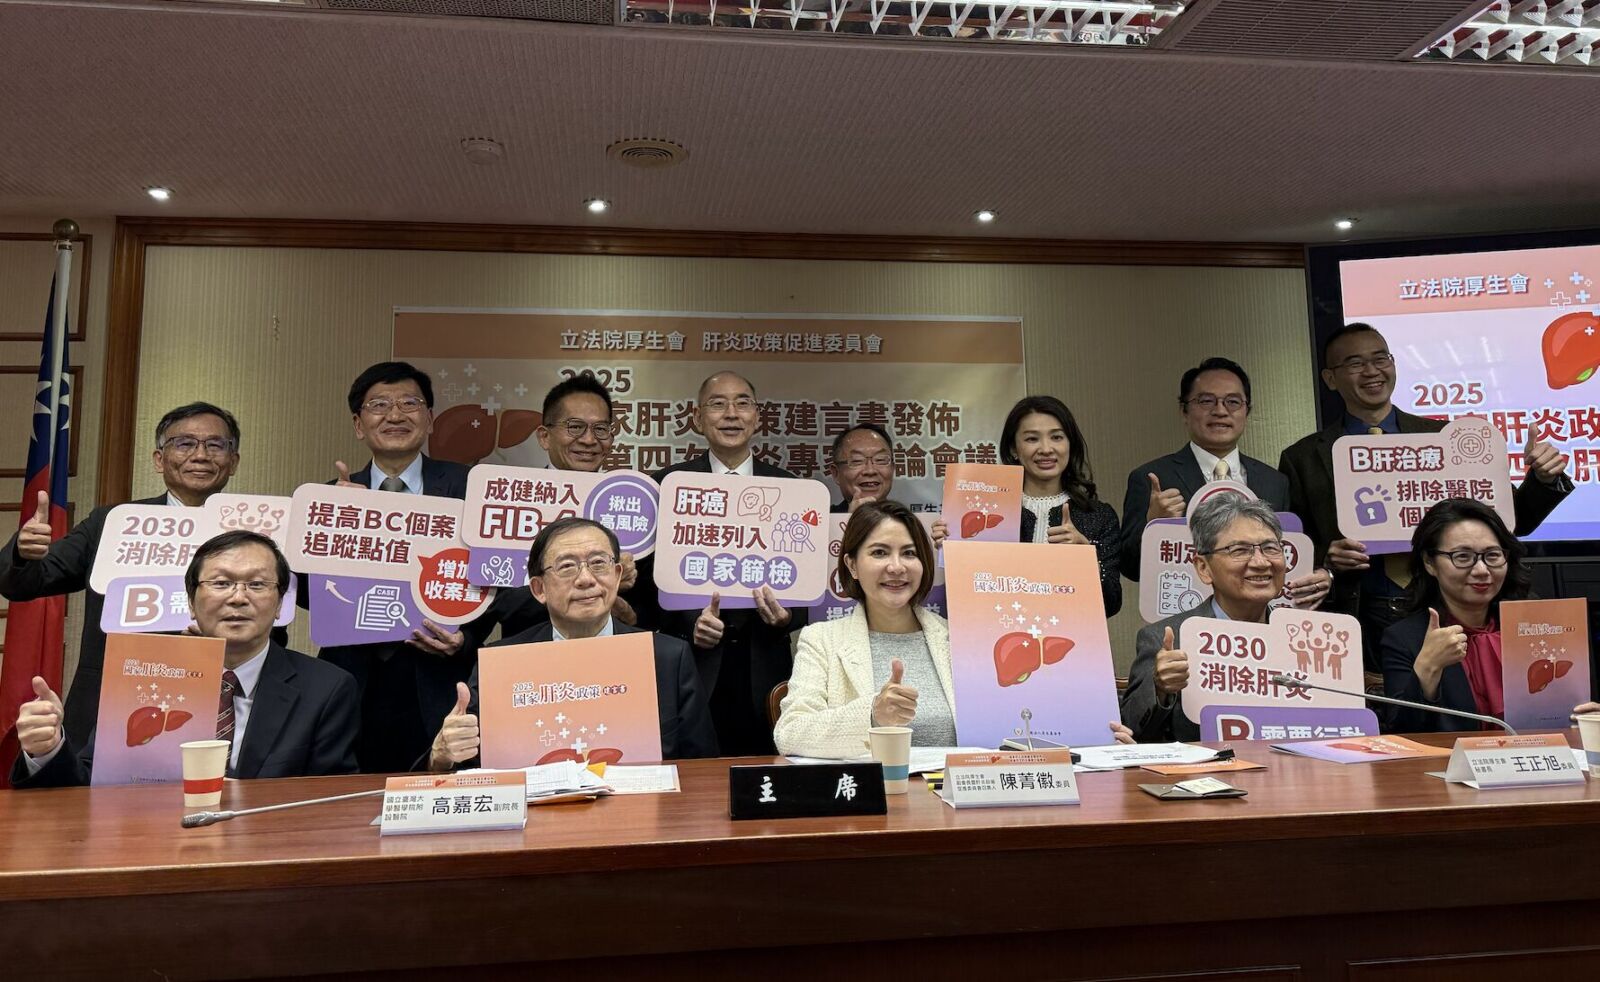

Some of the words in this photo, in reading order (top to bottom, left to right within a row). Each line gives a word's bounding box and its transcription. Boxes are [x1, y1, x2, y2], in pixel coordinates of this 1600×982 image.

[1399, 273, 1529, 299] 立法院厚生會
[560, 330, 686, 351] 立法院厚生會
[702, 332, 883, 353] 肝炎政策促進委員會
[560, 368, 632, 393] 25
[1414, 383, 1484, 406] 2025
[611, 401, 961, 437] 家肝炎策建言書發佈
[1350, 446, 1445, 472] B肝治療
[484, 478, 581, 506] 成健納入
[608, 494, 641, 512] 揪出
[674, 487, 728, 517] 肝癌
[1396, 479, 1495, 502] 排除醫院
[122, 516, 195, 537] 2030
[307, 501, 456, 539] 提高BC個案
[480, 504, 577, 541] FIB-
[600, 514, 649, 532] 高風險
[302, 531, 411, 564] 追蹤點值
[672, 522, 767, 550] 加速列入
[684, 556, 793, 585] 國家篩檢
[376, 588, 395, 597] CASE
[424, 581, 482, 603] 收案量
[121, 584, 163, 626] B
[1199, 632, 1267, 661] 2030
[513, 682, 534, 692] 2025
[1200, 662, 1312, 701] 消除肝炎
[513, 682, 601, 707] 國家肝炎政策
[1510, 755, 1562, 773] 王正旭
[1000, 771, 1056, 791] 陳菁徽
[432, 795, 494, 816] 高嘉宏
[493, 801, 519, 812] 副院長
